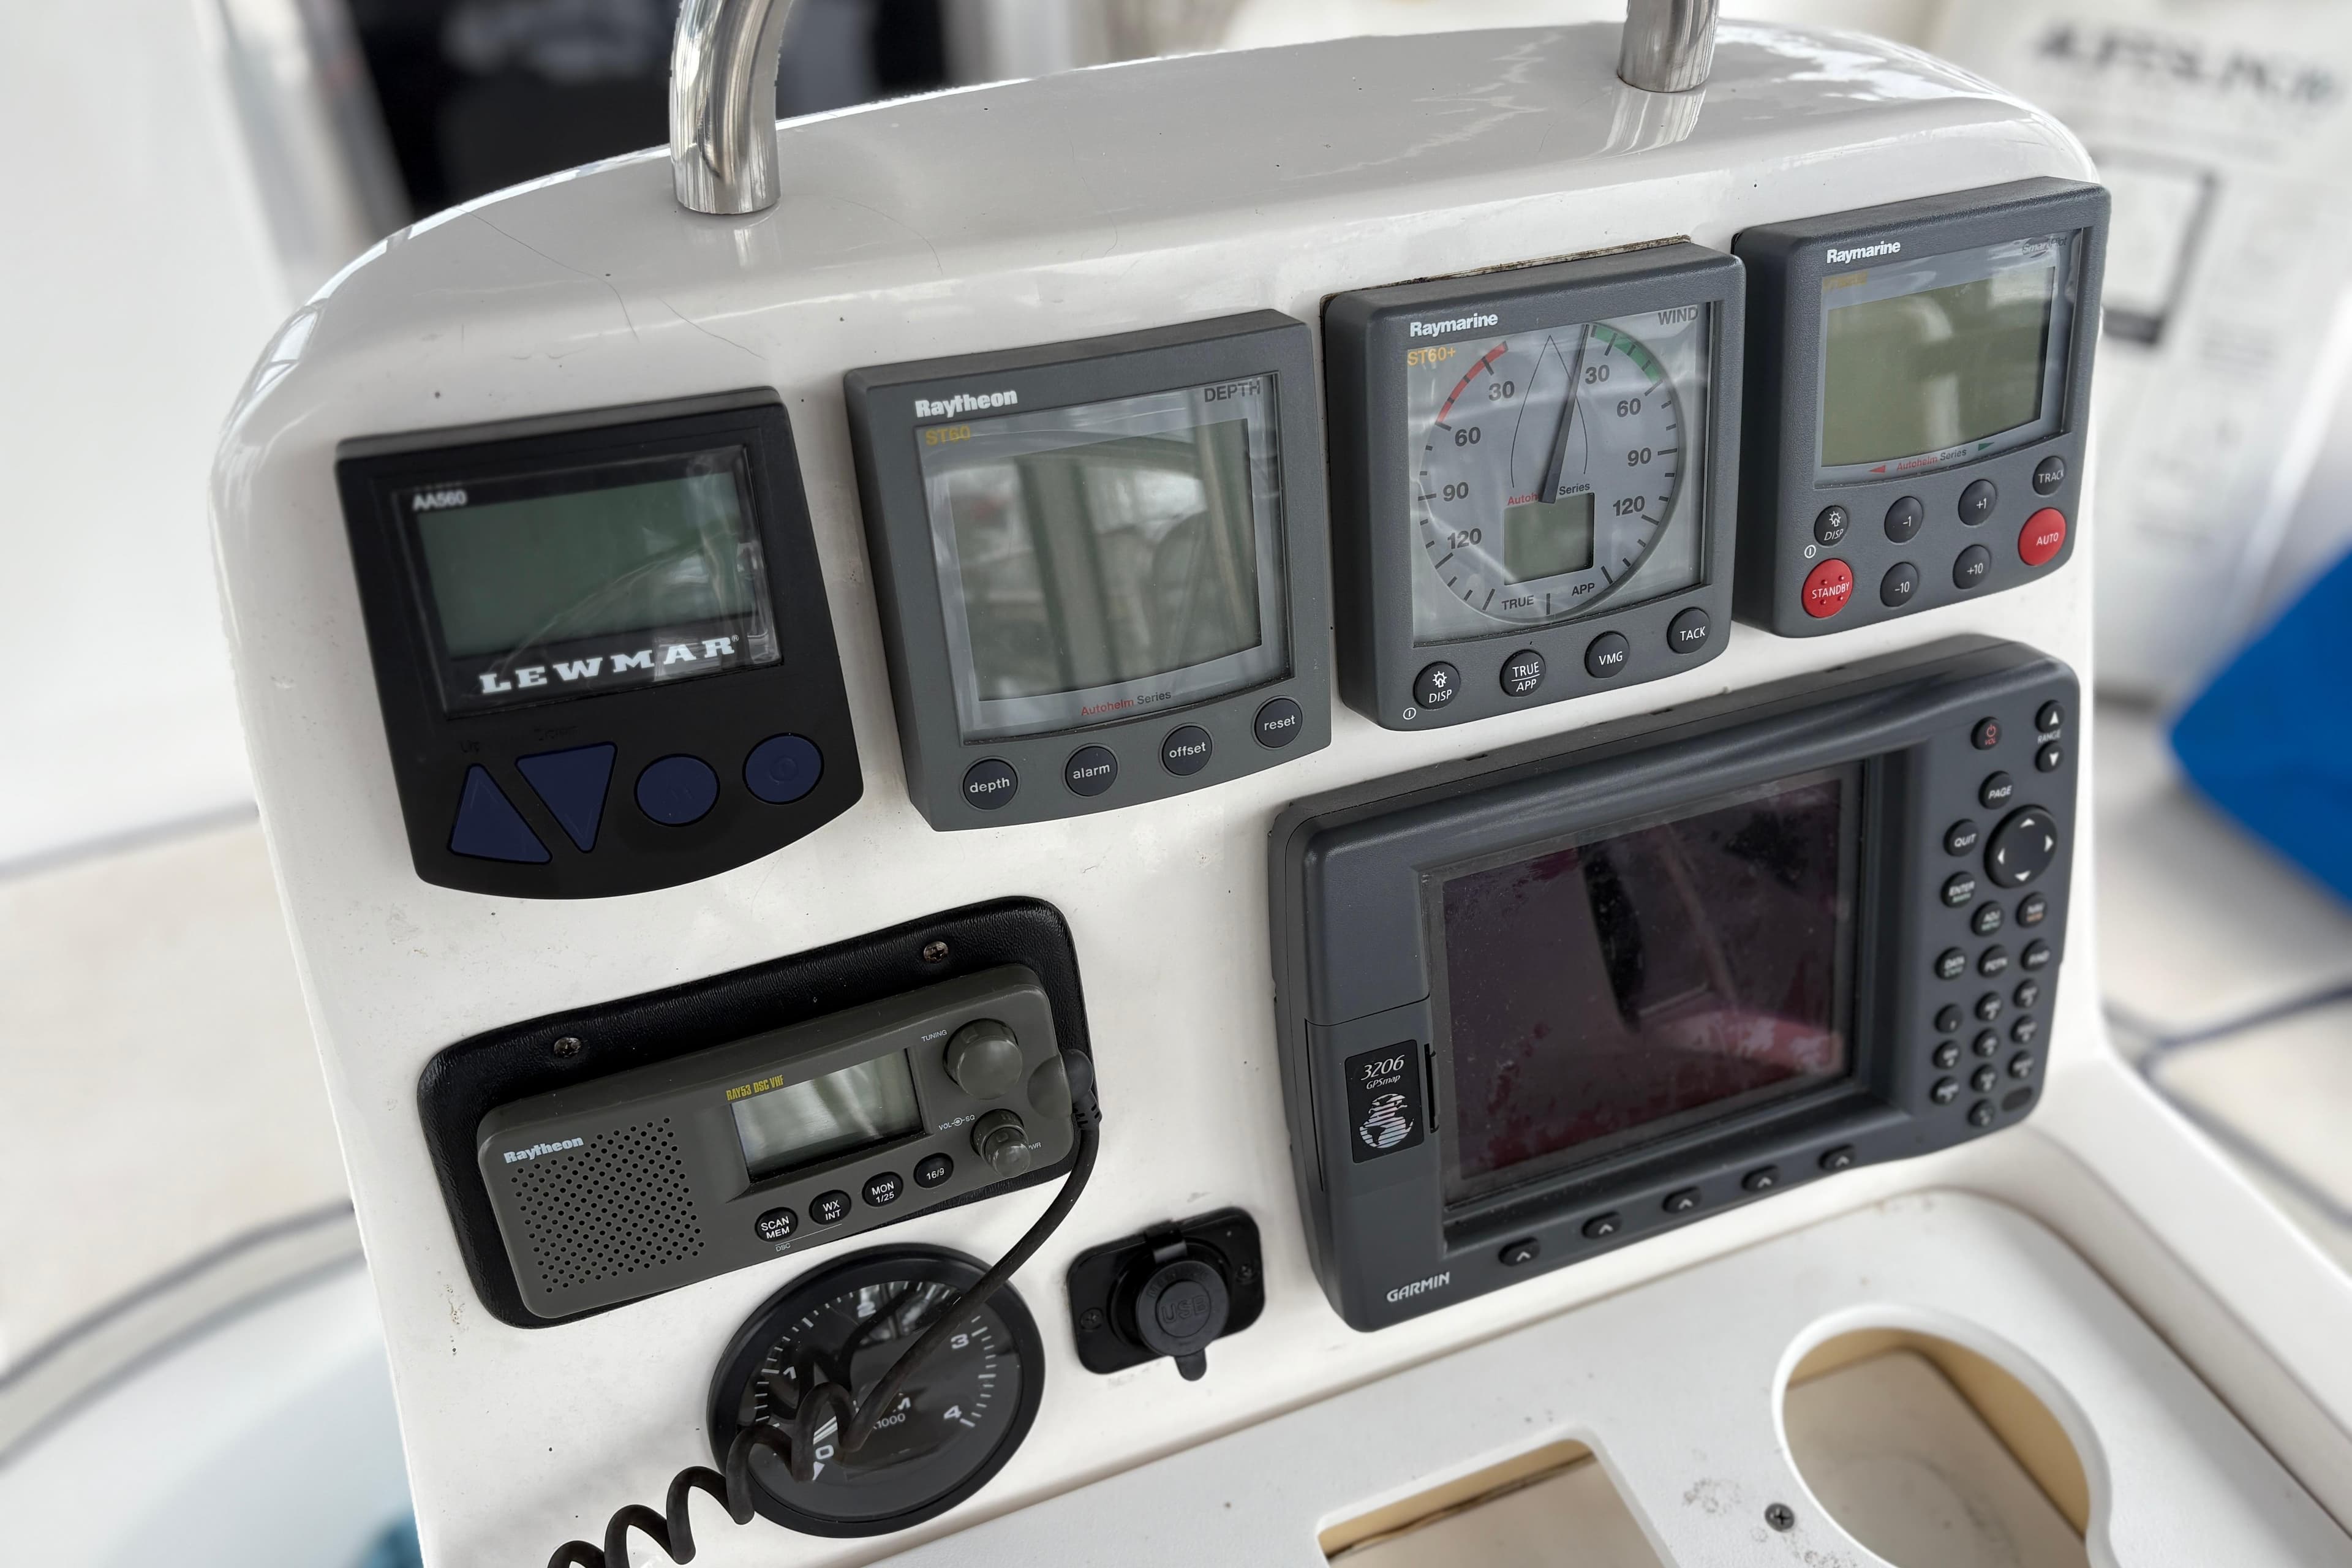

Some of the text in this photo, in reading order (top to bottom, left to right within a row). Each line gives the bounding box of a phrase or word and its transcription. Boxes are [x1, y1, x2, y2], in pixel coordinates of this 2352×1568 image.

[1826, 240, 1901, 265] Raymarine
[1657, 306, 1699, 325] WIND
[1409, 312, 1499, 338] Raymarine
[1407, 347, 1457, 366] ST60+
[1584, 364, 1610, 385] 30
[1204, 380, 1261, 403] DEPTH
[1488, 380, 1515, 402] 30
[914, 390, 1018, 418] Raytheon
[1616, 398, 1642, 418] 60
[924, 424, 971, 447] ST60
[1453, 426, 1482, 447] 60
[1626, 447, 1652, 467] 90
[1896, 448, 1967, 472] Autohelm Series
[2038, 470, 2064, 484] TRACK
[1442, 481, 1469, 502] 90
[1559, 483, 1591, 496] Series
[412, 489, 468, 511] AA560
[1612, 495, 1646, 516] 120
[1975, 497, 1987, 510] +1
[1902, 516, 1912, 527] -1
[1447, 527, 1482, 549] 120
[1823, 528, 1844, 541] DISP
[2035, 532, 2059, 546] AUTO
[1966, 563, 1984, 576] +10
[1571, 582, 1596, 597] APP
[1811, 581, 1850, 599] STANDBY
[1894, 581, 1910, 594] -10
[1501, 595, 1535, 611] TRUE
[1679, 625, 1706, 642] TACK
[1598, 652, 1624, 666] VMG
[1512, 662, 1540, 678] TRUE
[1515, 679, 1537, 693] APP
[1080, 691, 1172, 717] Autohelm Series
[1428, 689, 1453, 704] DISP
[1263, 715, 1297, 732] reset
[2038, 729, 2061, 744] RANGE
[1168, 742, 1207, 759] offset
[1072, 763, 1110, 780] alarm
[969, 777, 1011, 795] depth
[1988, 785, 2013, 799] PAGE
[1954, 834, 1977, 848] QUIT
[921, 1029, 948, 1042] TUNING
[1360, 1054, 1406, 1080] 3206
[725, 1074, 785, 1101] RAY53 DSC VHF
[1366, 1074, 1401, 1090] GPSmap
[938, 1121, 952, 1131] VOL
[503, 1137, 584, 1164] Raytheon
[925, 1167, 945, 1181] 16/9
[871, 1181, 895, 1196] MON
[875, 1191, 895, 1204] 1/25
[822, 1199, 840, 1213] WX
[824, 1209, 842, 1221] INT
[760, 1216, 790, 1232] SCAN
[766, 1226, 791, 1240] MEM
[775, 1242, 791, 1253] DSC
[1386, 1271, 1450, 1303] GARMIN
[857, 1301, 876, 1318] 2
[1161, 1294, 1208, 1324] USB
[950, 1333, 970, 1350] 3
[783, 1366, 797, 1379] 1
[943, 1405, 962, 1421] 4
[815, 1444, 835, 1460] 0
